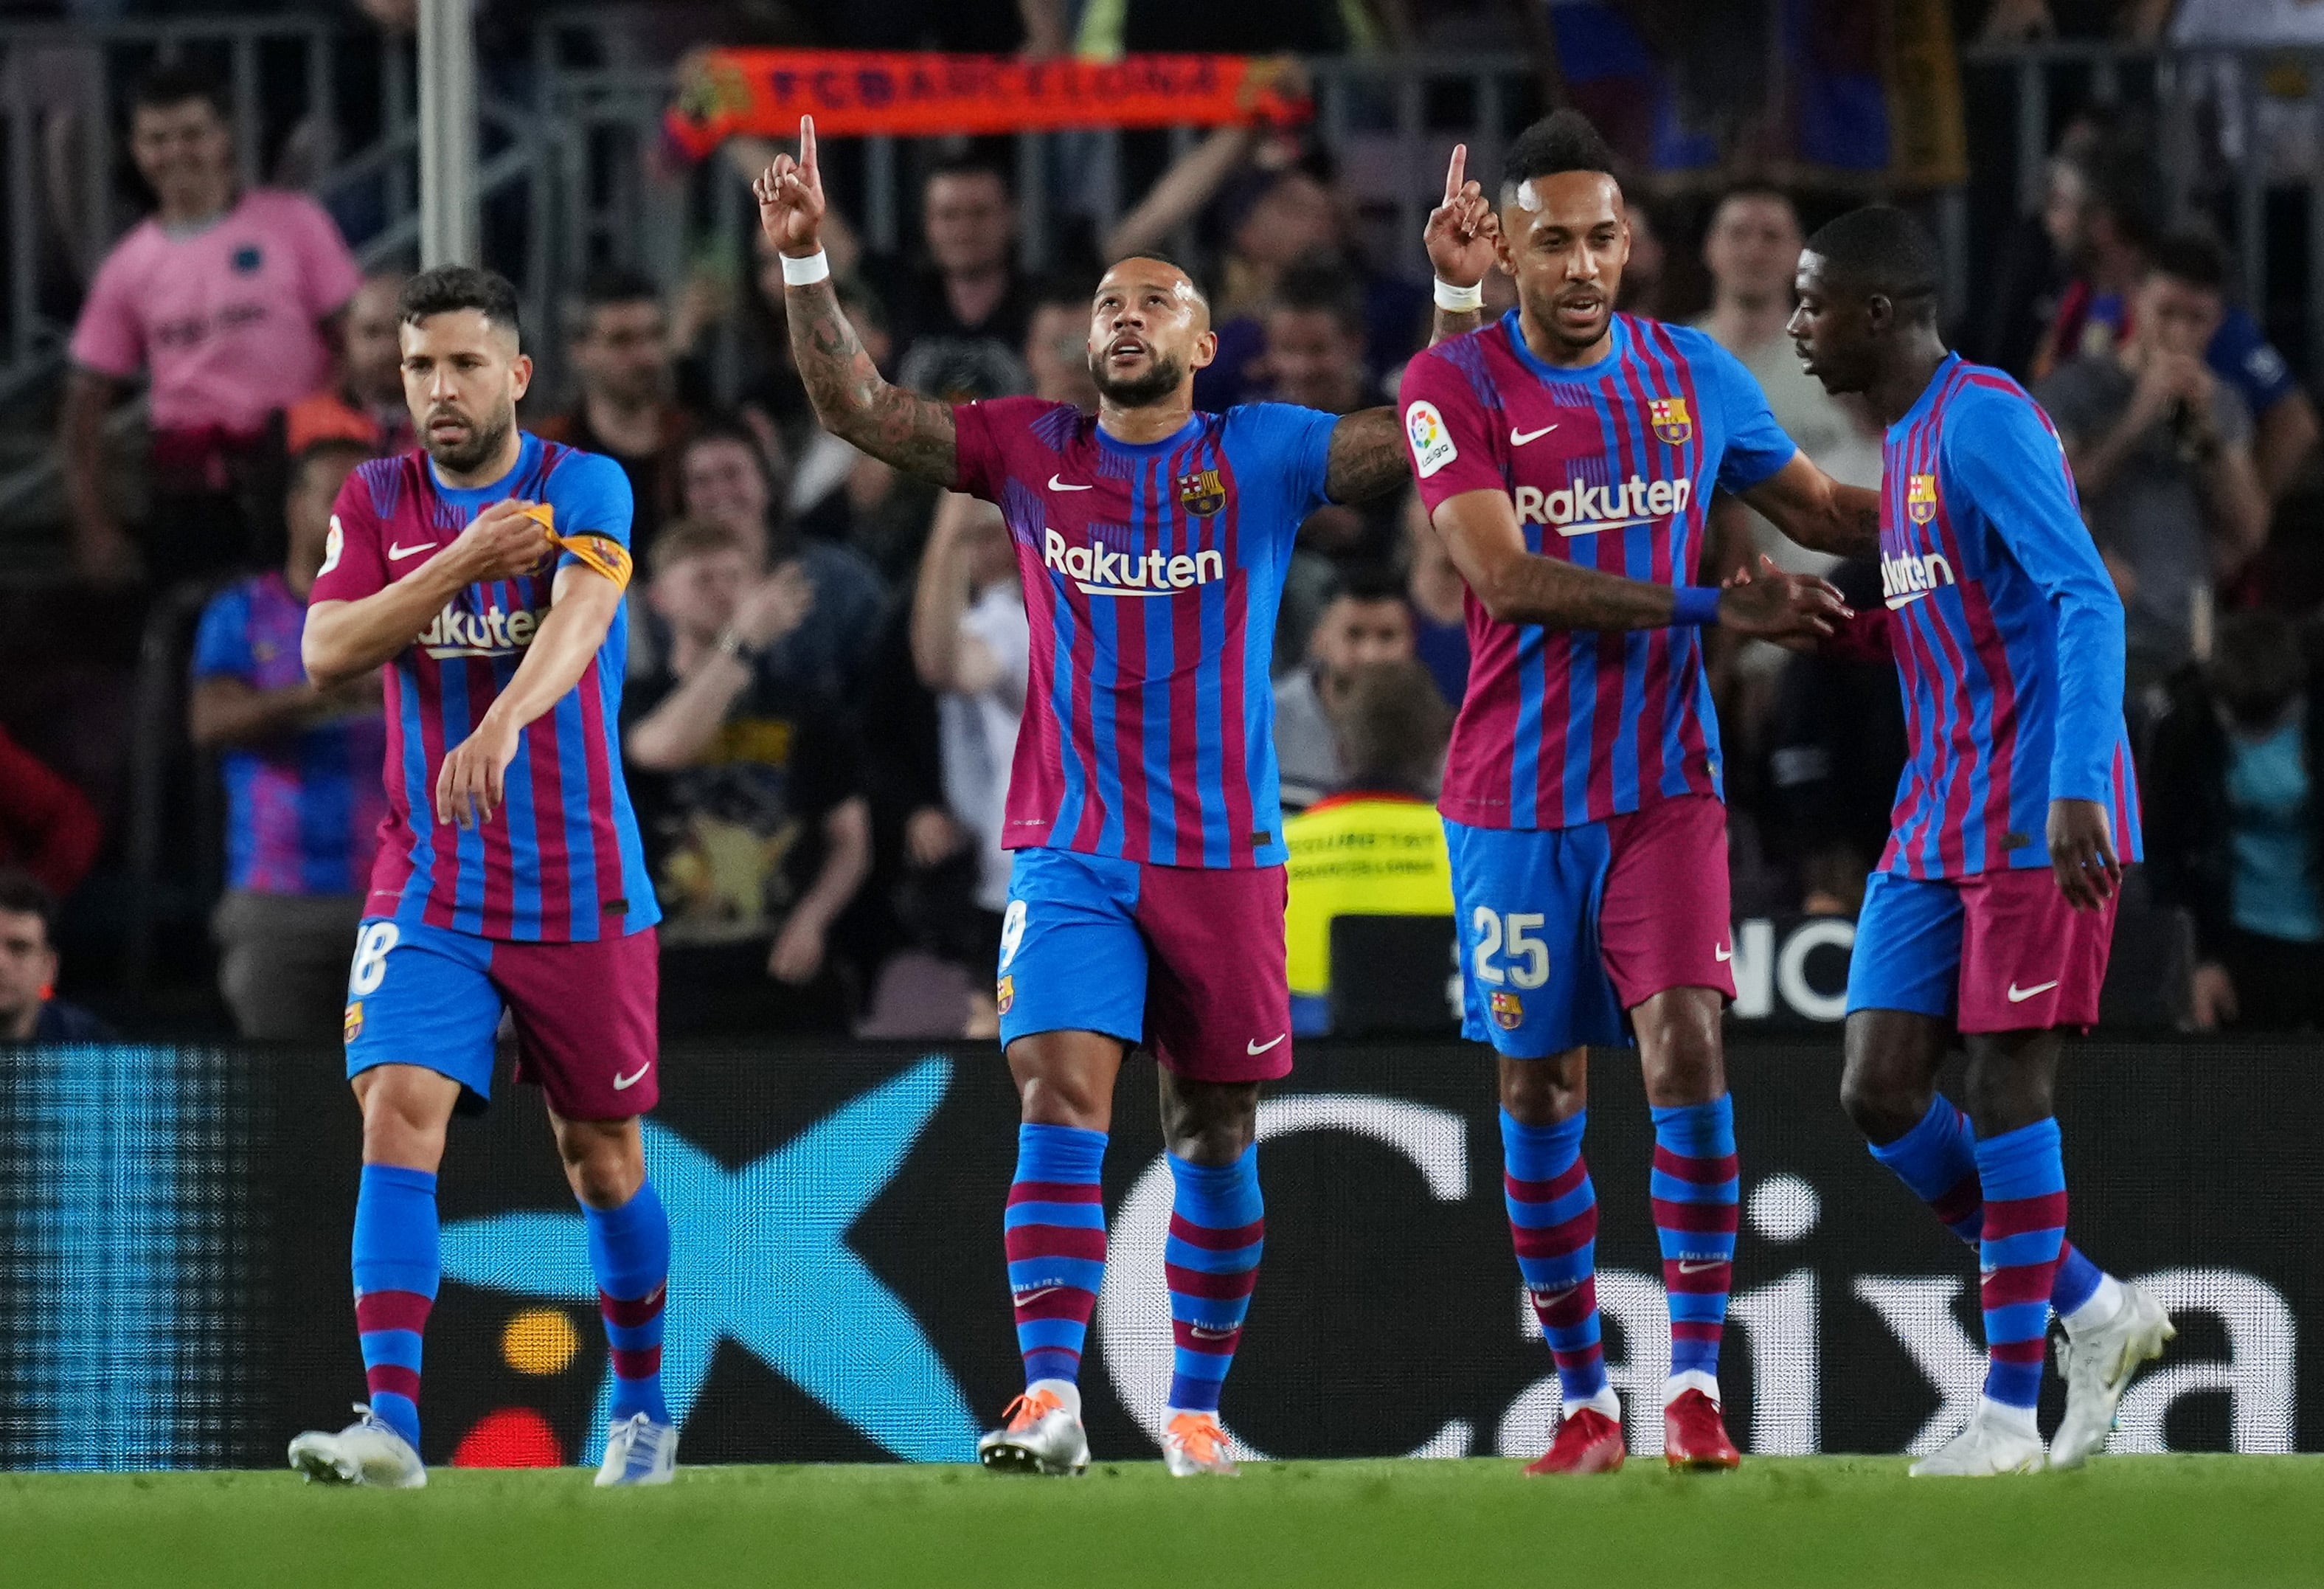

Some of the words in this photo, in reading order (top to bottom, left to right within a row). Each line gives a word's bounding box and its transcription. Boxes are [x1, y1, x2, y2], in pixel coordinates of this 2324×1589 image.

[1514, 474, 1691, 526] Rakuten
[1044, 527, 1223, 589] Rakuten
[1000, 899, 1027, 969] 9
[1473, 906, 1550, 990] 25
[1099, 1093, 2297, 1459] Caixa
